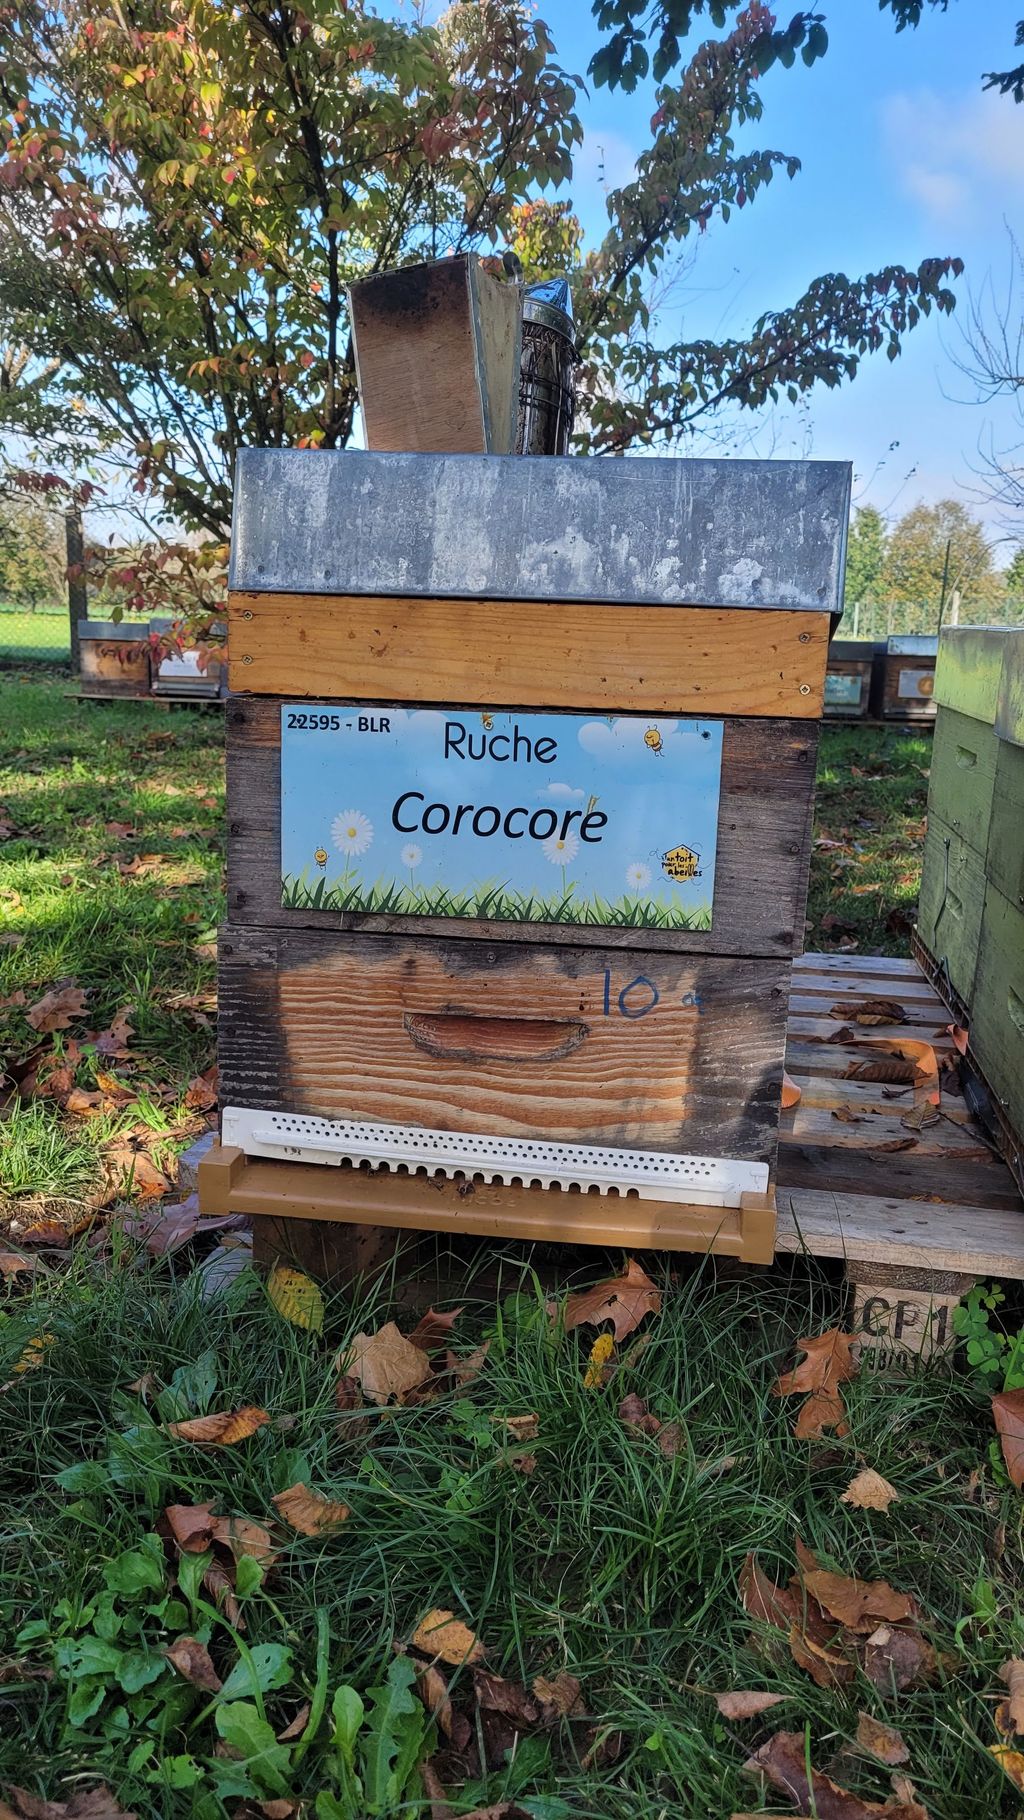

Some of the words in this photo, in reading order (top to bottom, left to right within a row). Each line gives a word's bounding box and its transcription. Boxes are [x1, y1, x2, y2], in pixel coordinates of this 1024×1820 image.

[287, 713, 340, 731] 22595
[358, 716, 391, 733] BLR
[444, 721, 558, 764] Ruche
[391, 791, 609, 843] Corocore
[668, 864, 702, 876] abeilles
[675, 852, 694, 862] toit
[603, 968, 660, 1019] 10
